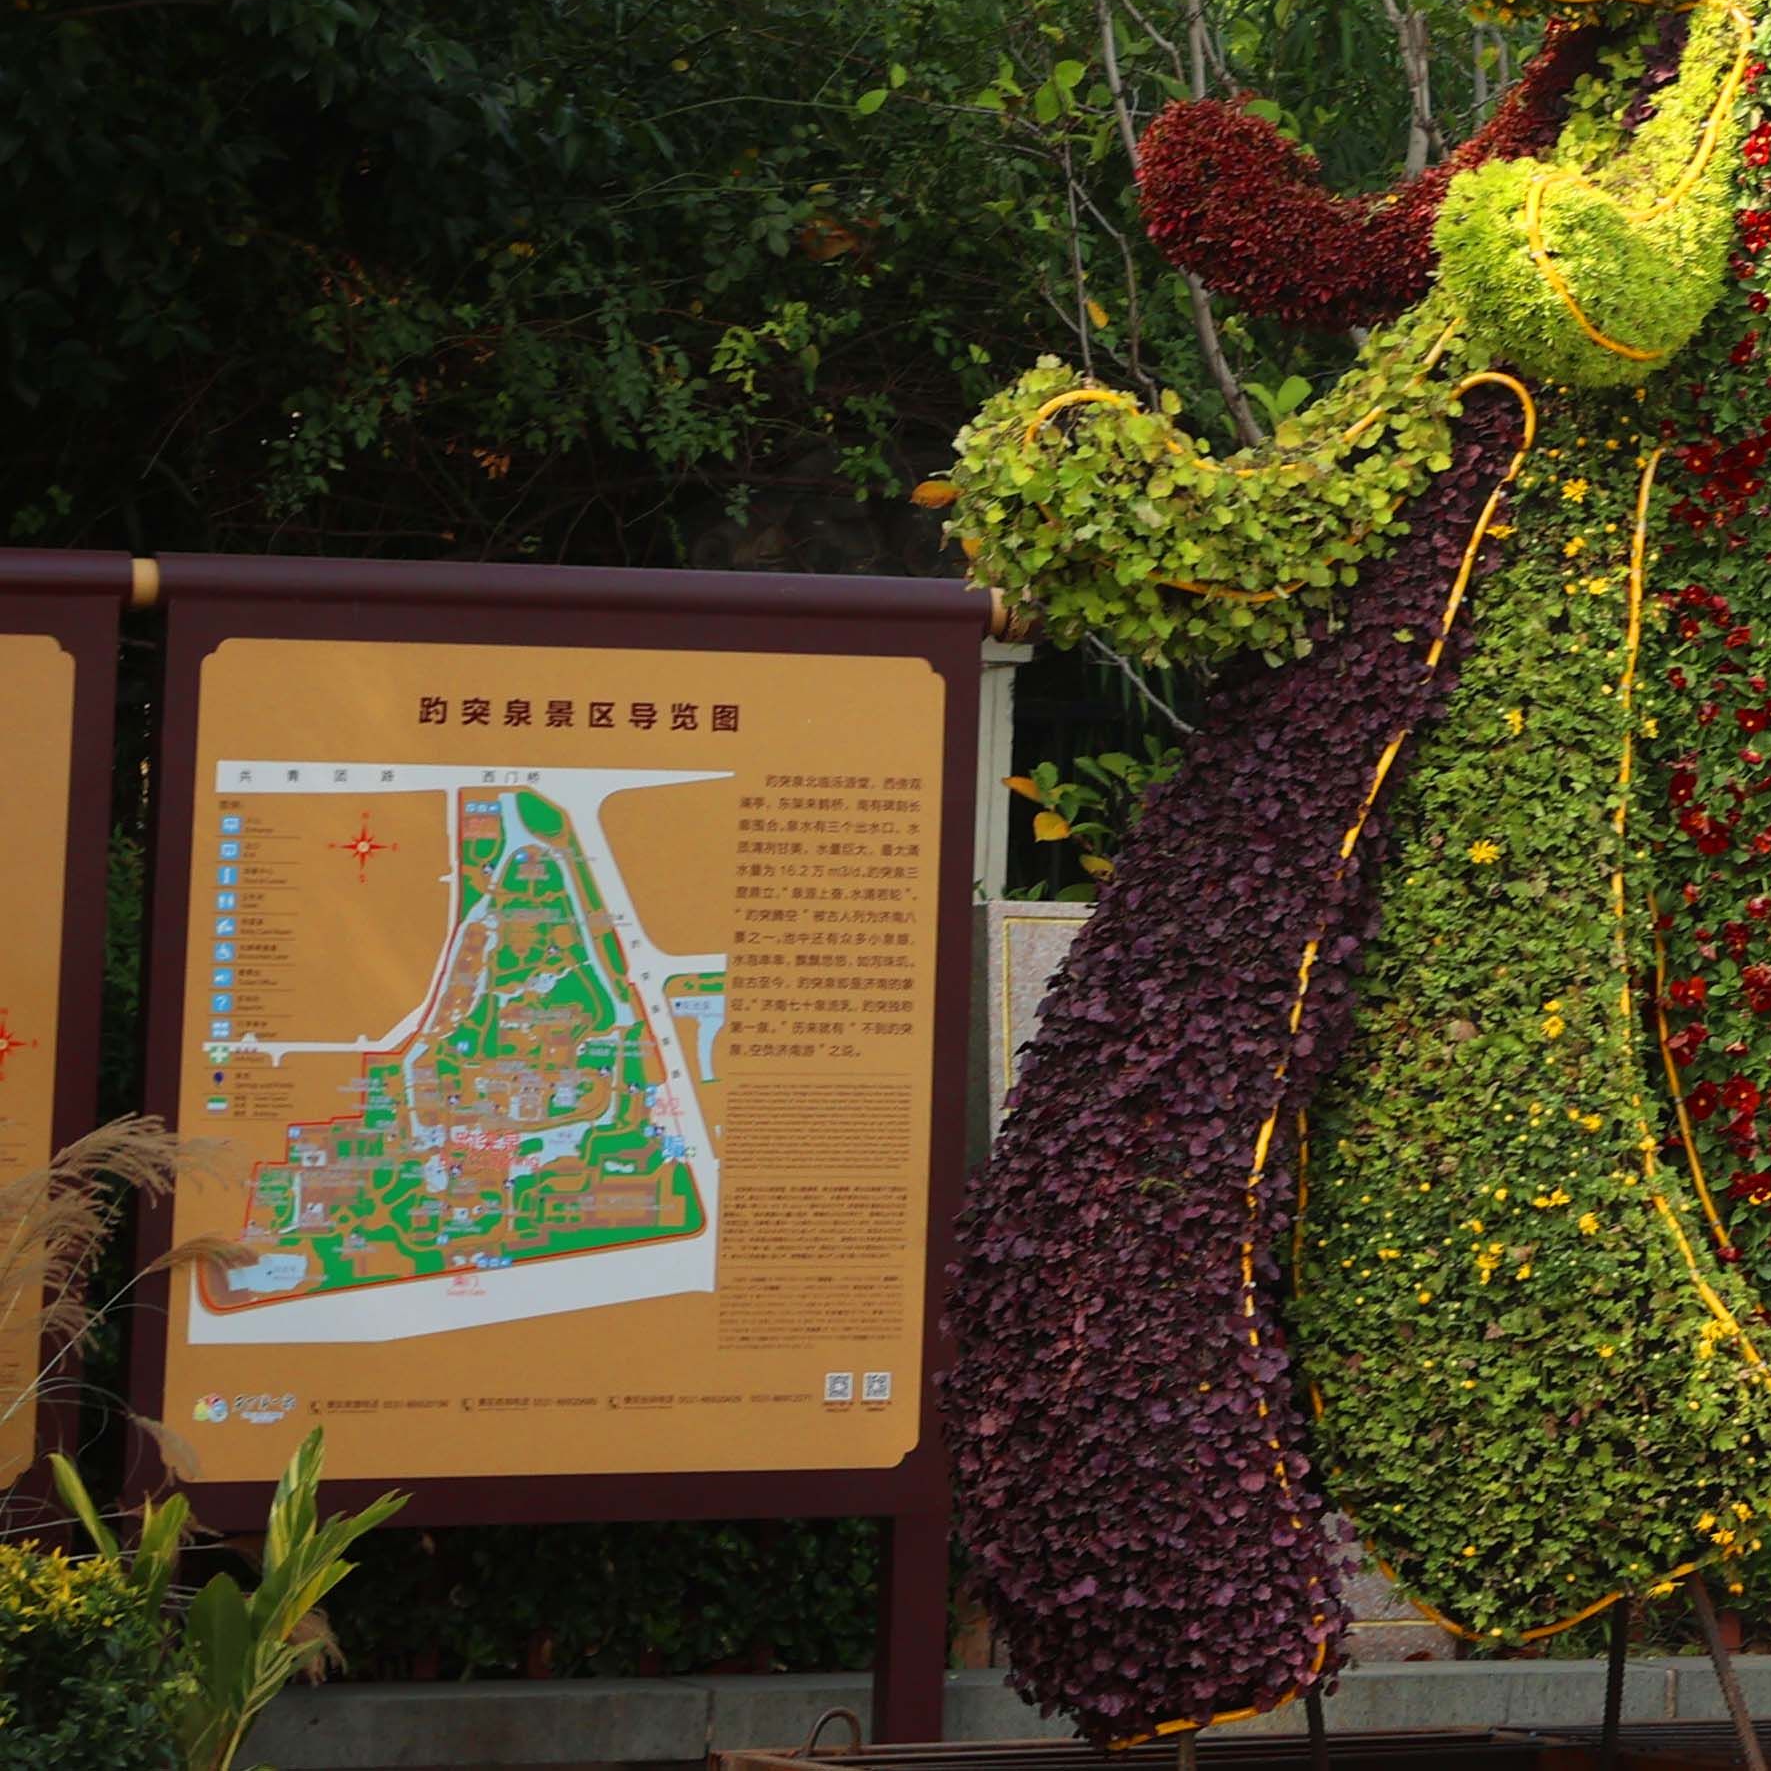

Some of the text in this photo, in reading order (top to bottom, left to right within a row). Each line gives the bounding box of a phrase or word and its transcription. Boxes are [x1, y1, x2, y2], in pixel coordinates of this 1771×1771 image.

[418, 696, 740, 732] 趵突泉景区导览图
[240, 769, 395, 782] 共青团路
[482, 770, 541, 783] 西门桥
